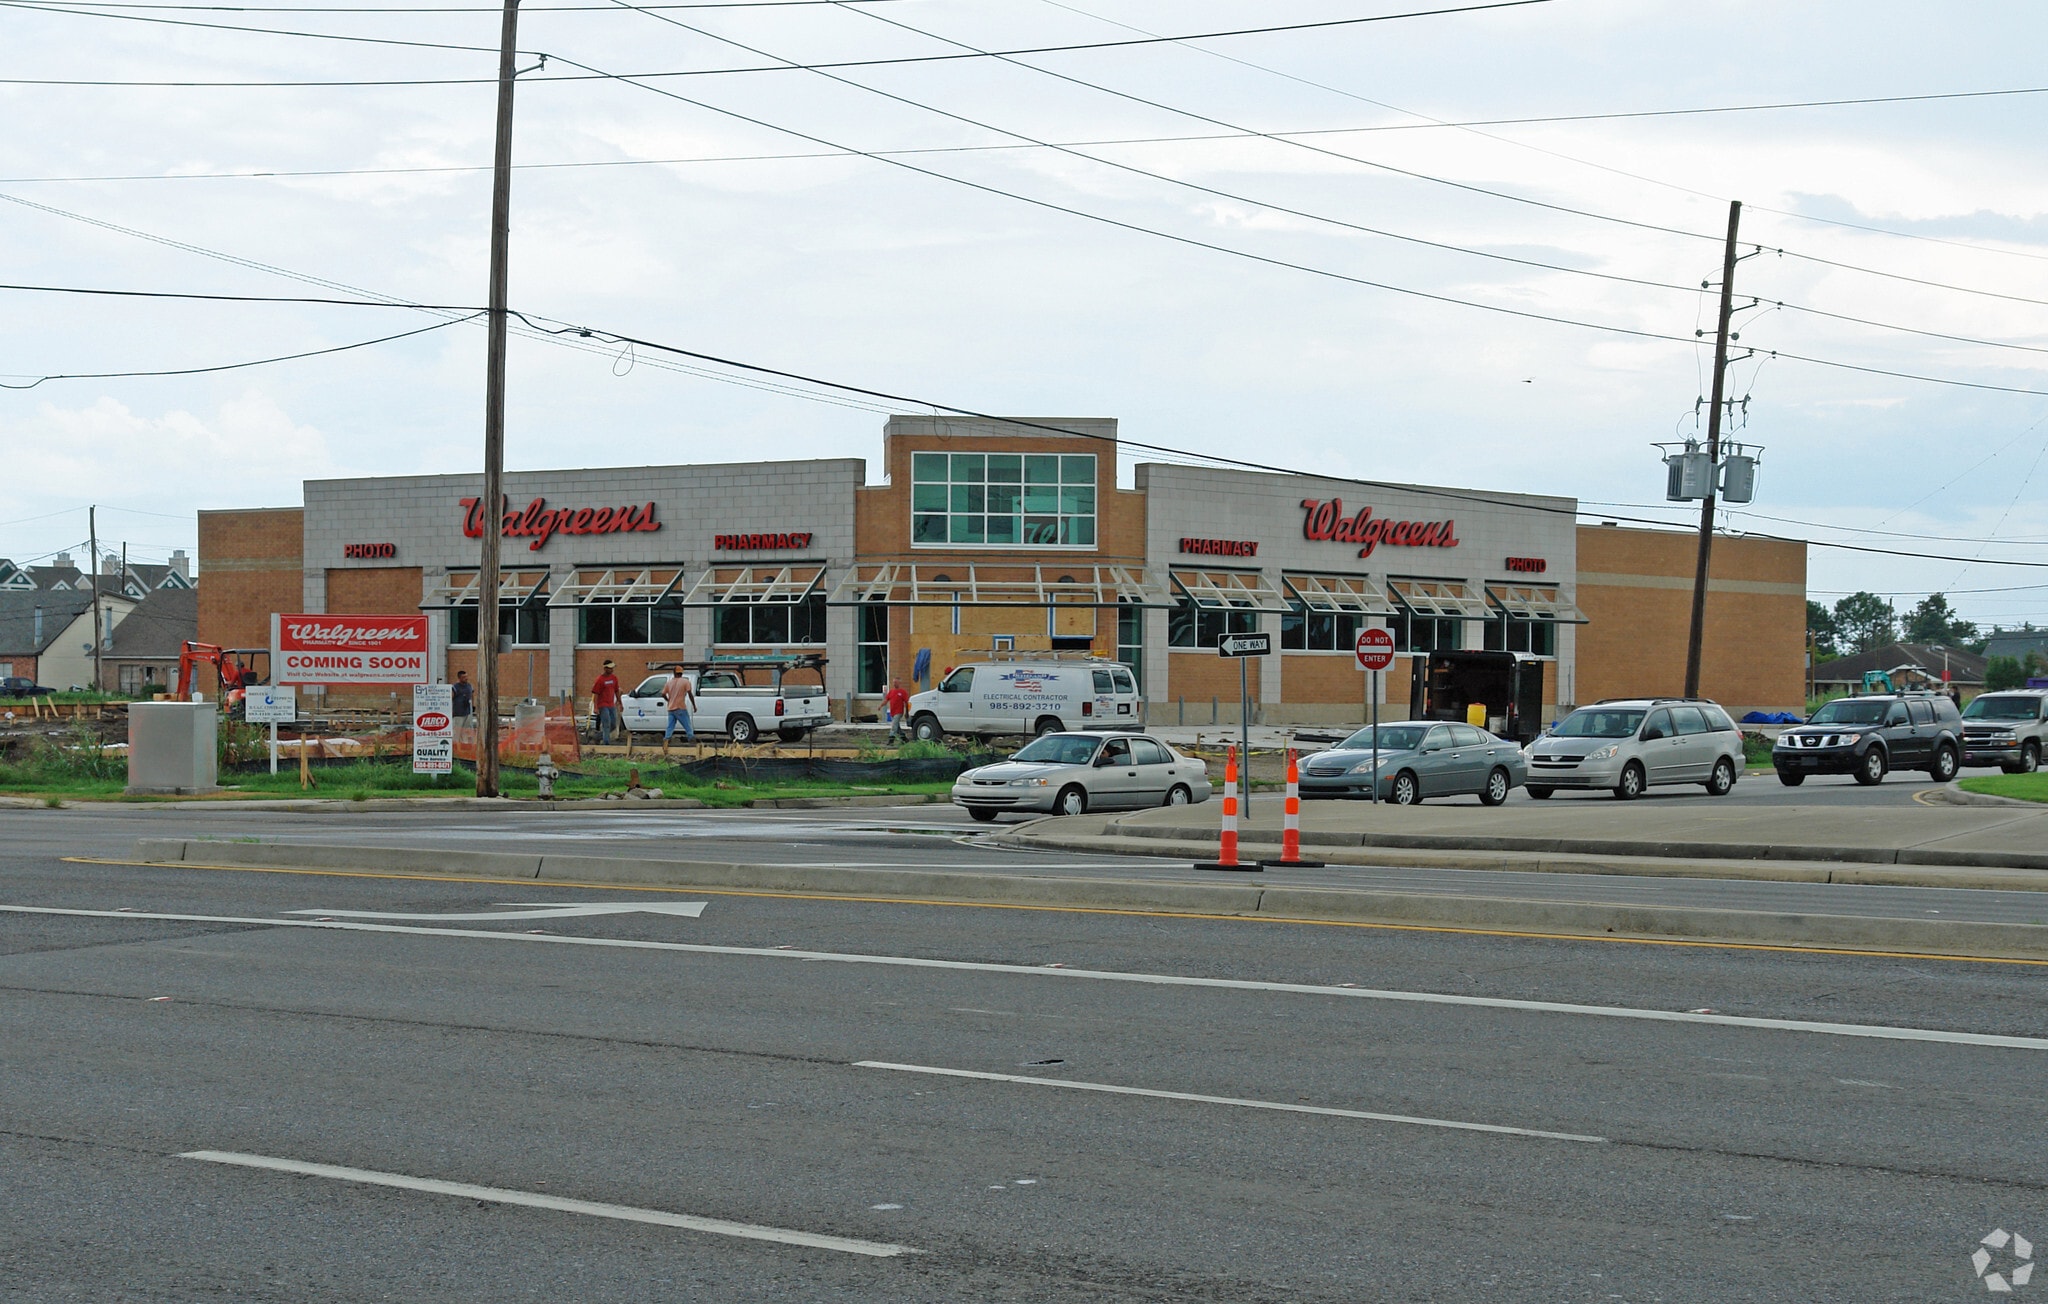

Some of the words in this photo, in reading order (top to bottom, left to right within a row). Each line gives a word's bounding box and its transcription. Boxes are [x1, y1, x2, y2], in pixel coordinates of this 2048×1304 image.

[459, 494, 662, 551] Walgreens
[1301, 497, 1459, 558] Walgreens
[714, 532, 813, 550] PHARMACY
[1180, 537, 1259, 557] PHARMACY
[344, 542, 395, 558] PHOTO
[1506, 556, 1547, 573] PHOTO
[287, 623, 420, 646] Walgreens
[1233, 640, 1247, 650] ONE
[1249, 639, 1265, 649] WAY
[286, 656, 362, 668] COMING
[368, 657, 420, 669] SOON
[990, 702, 1061, 710] 985-892-3210
[420, 717, 447, 727] JARCO
[416, 749, 448, 757] QUALITY
